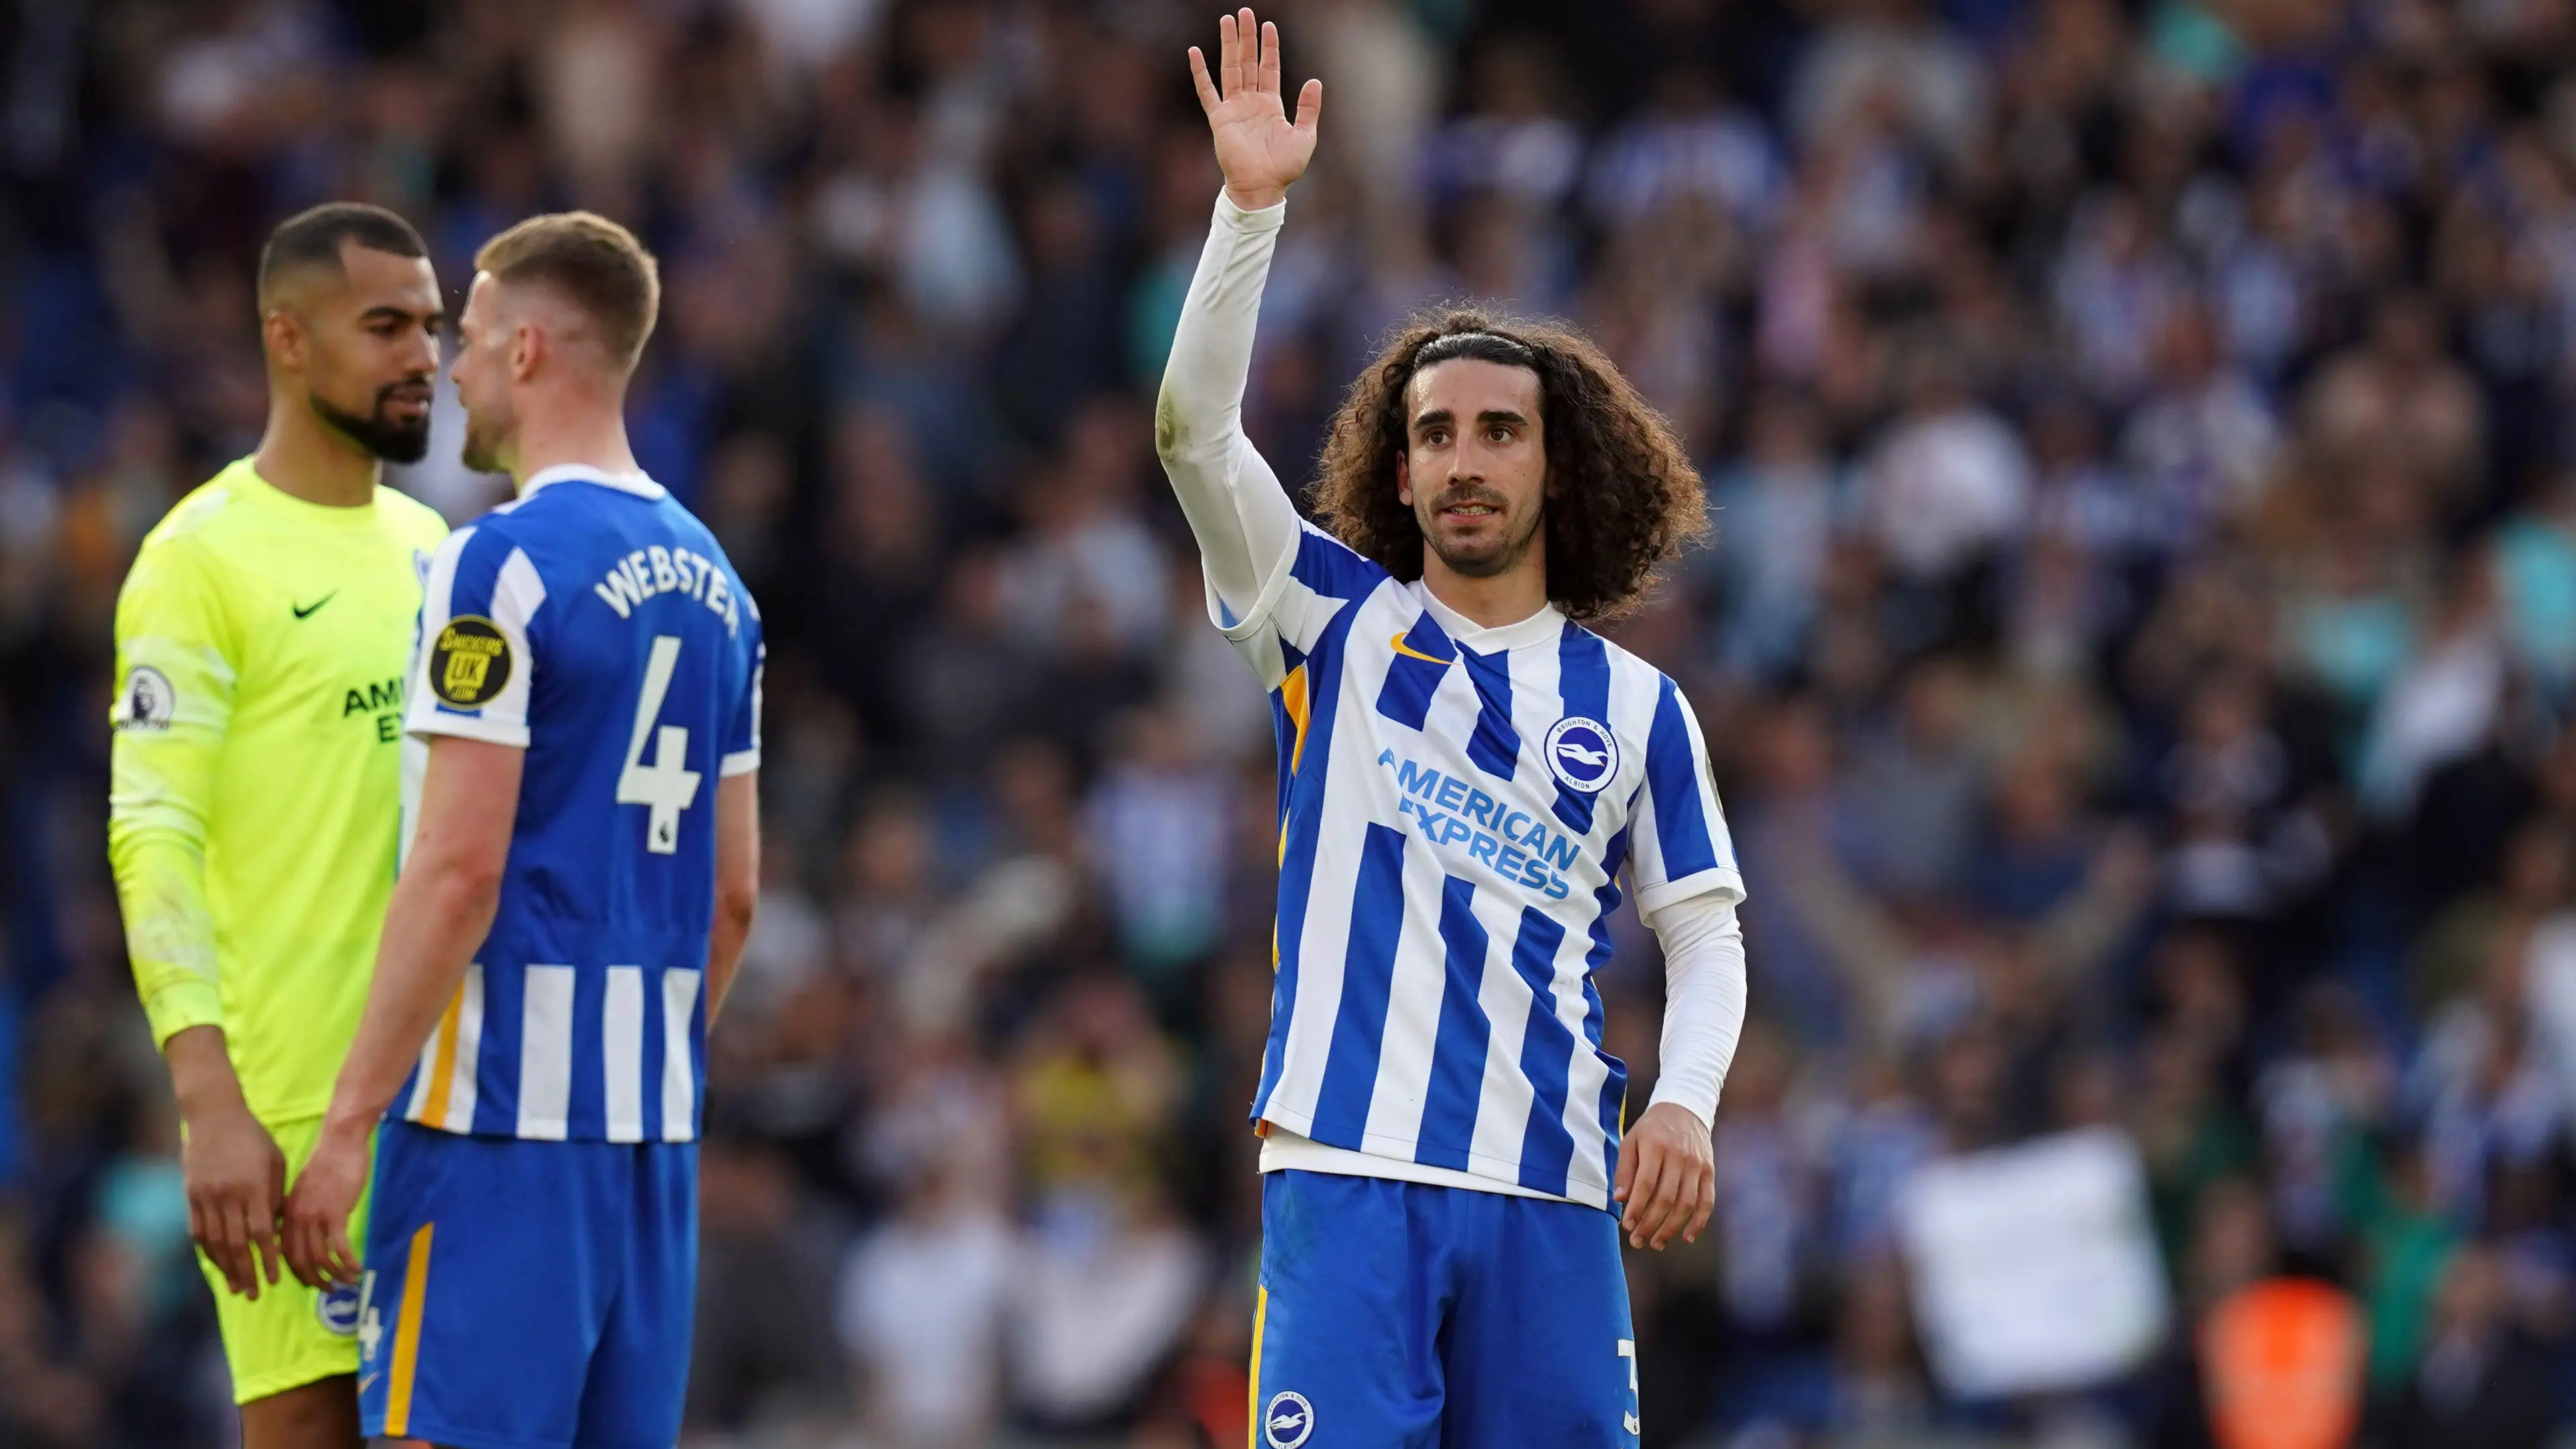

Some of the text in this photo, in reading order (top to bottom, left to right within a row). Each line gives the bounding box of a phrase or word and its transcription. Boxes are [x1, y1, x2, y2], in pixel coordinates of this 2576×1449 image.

[451, 657, 483, 682] UK
[616, 635, 702, 855] 4
[1556, 719, 1591, 733] BRIGHTON
[1599, 730, 1613, 747] HOVE
[1564, 776, 1591, 789] ALBION
[1378, 746, 1580, 871] AMERICAN
